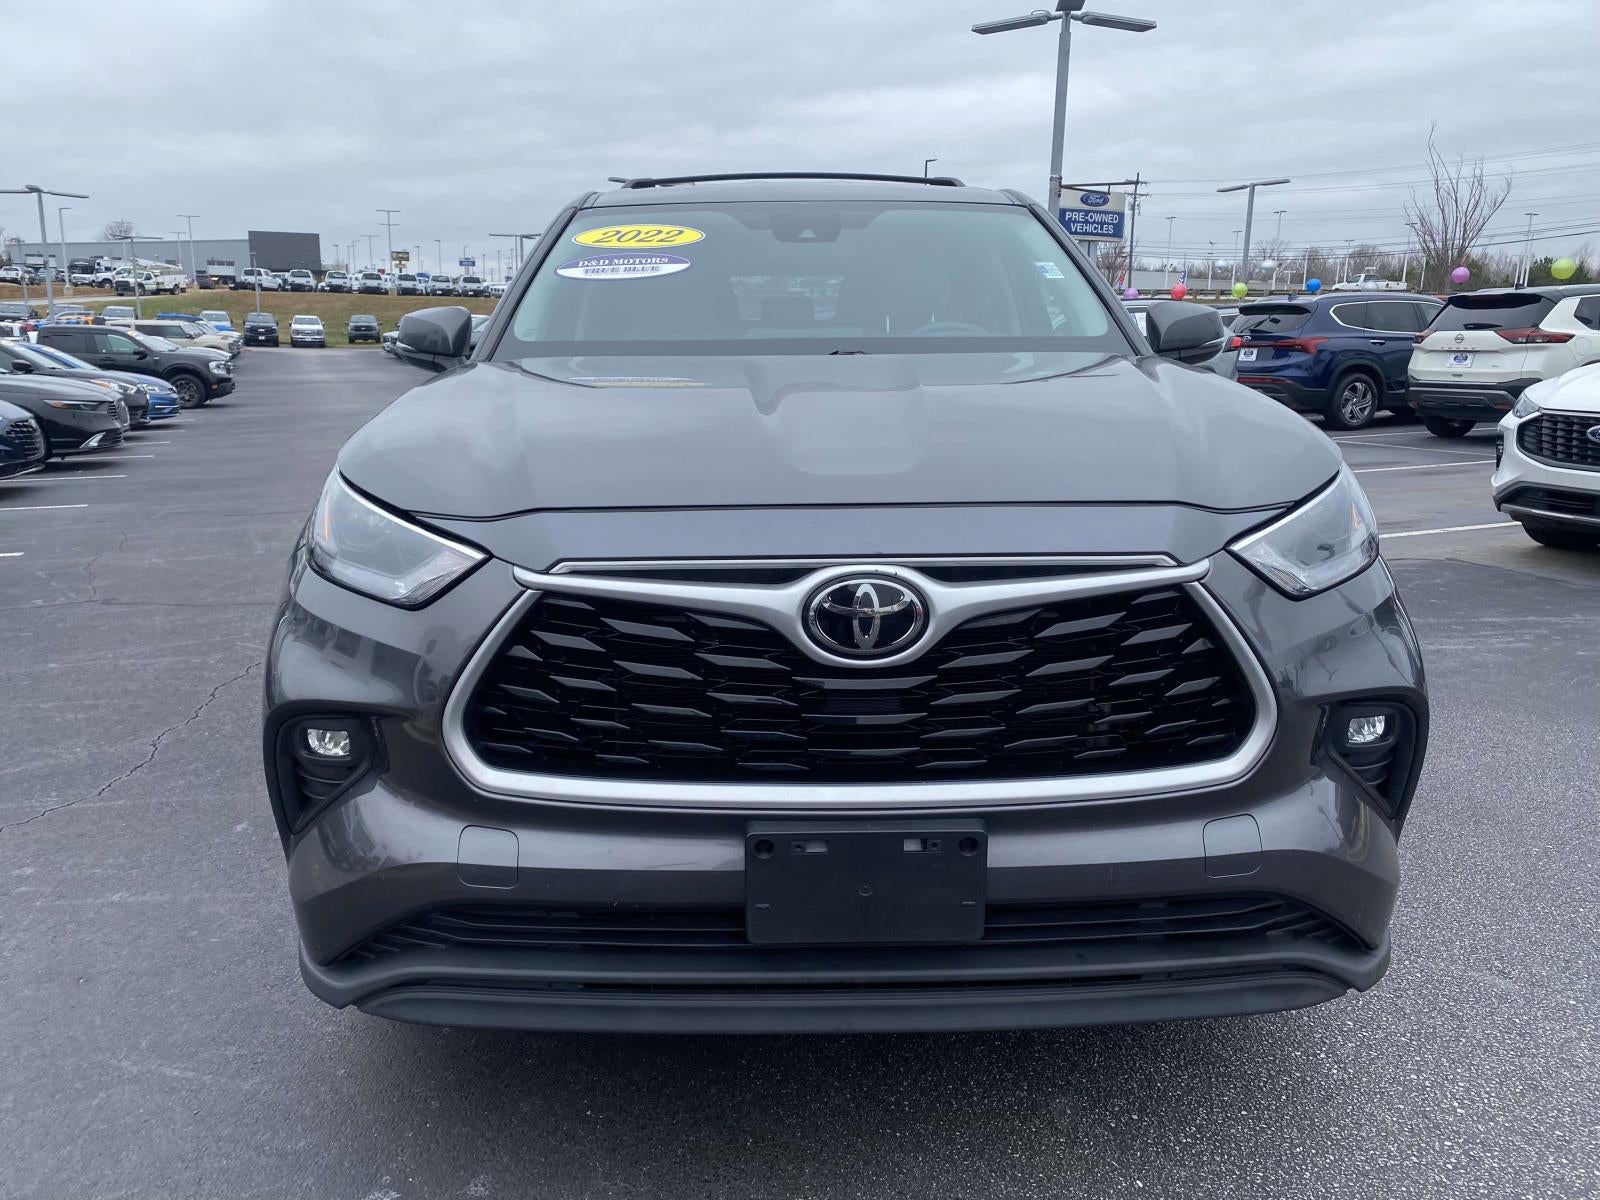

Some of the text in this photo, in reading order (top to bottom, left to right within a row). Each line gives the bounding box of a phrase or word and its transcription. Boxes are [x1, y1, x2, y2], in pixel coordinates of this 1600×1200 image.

[1065, 211, 1119, 224] PRE-OWNED
[1070, 223, 1114, 234] VEHICLES
[591, 229, 685, 244] 2022
[578, 257, 669, 267] D&D MOTORS
